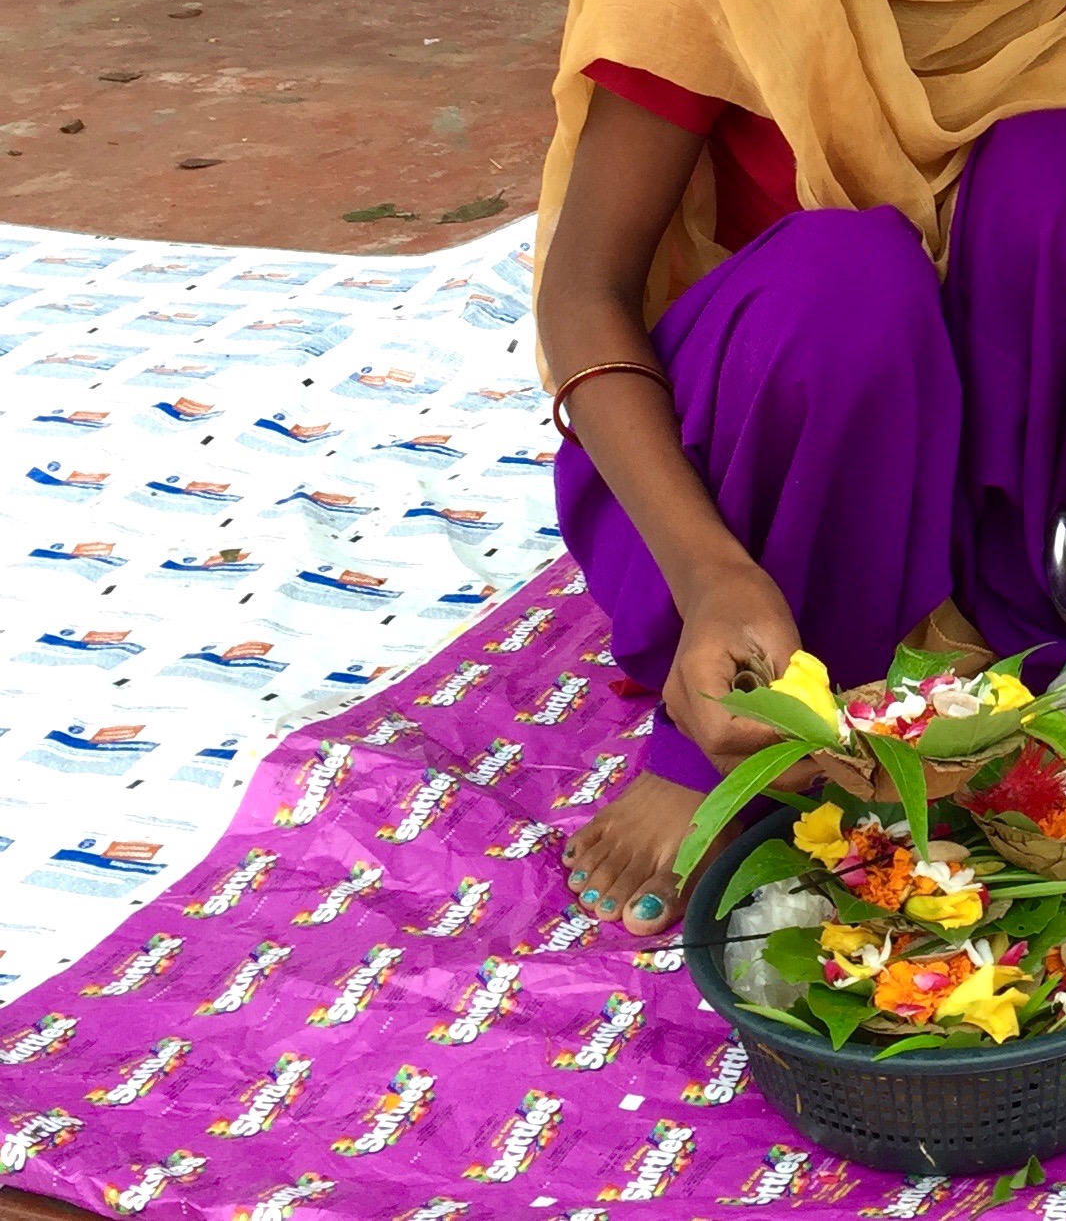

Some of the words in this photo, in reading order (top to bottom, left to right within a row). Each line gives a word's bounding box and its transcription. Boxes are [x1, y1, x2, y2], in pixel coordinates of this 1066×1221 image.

[432, 664, 489, 706] Skittles
[532, 676, 587, 725] Skittles
[294, 742, 352, 824] Skittles
[204, 852, 278, 915] Skittles
[327, 948, 402, 1024] Skittles
[450, 962, 521, 1043] Skittles
[576, 1000, 643, 1070] Skittles
[229, 1059, 311, 1137] Skittles
[486, 1098, 563, 1182] Skittles
[622, 1128, 694, 1202] Skittles
